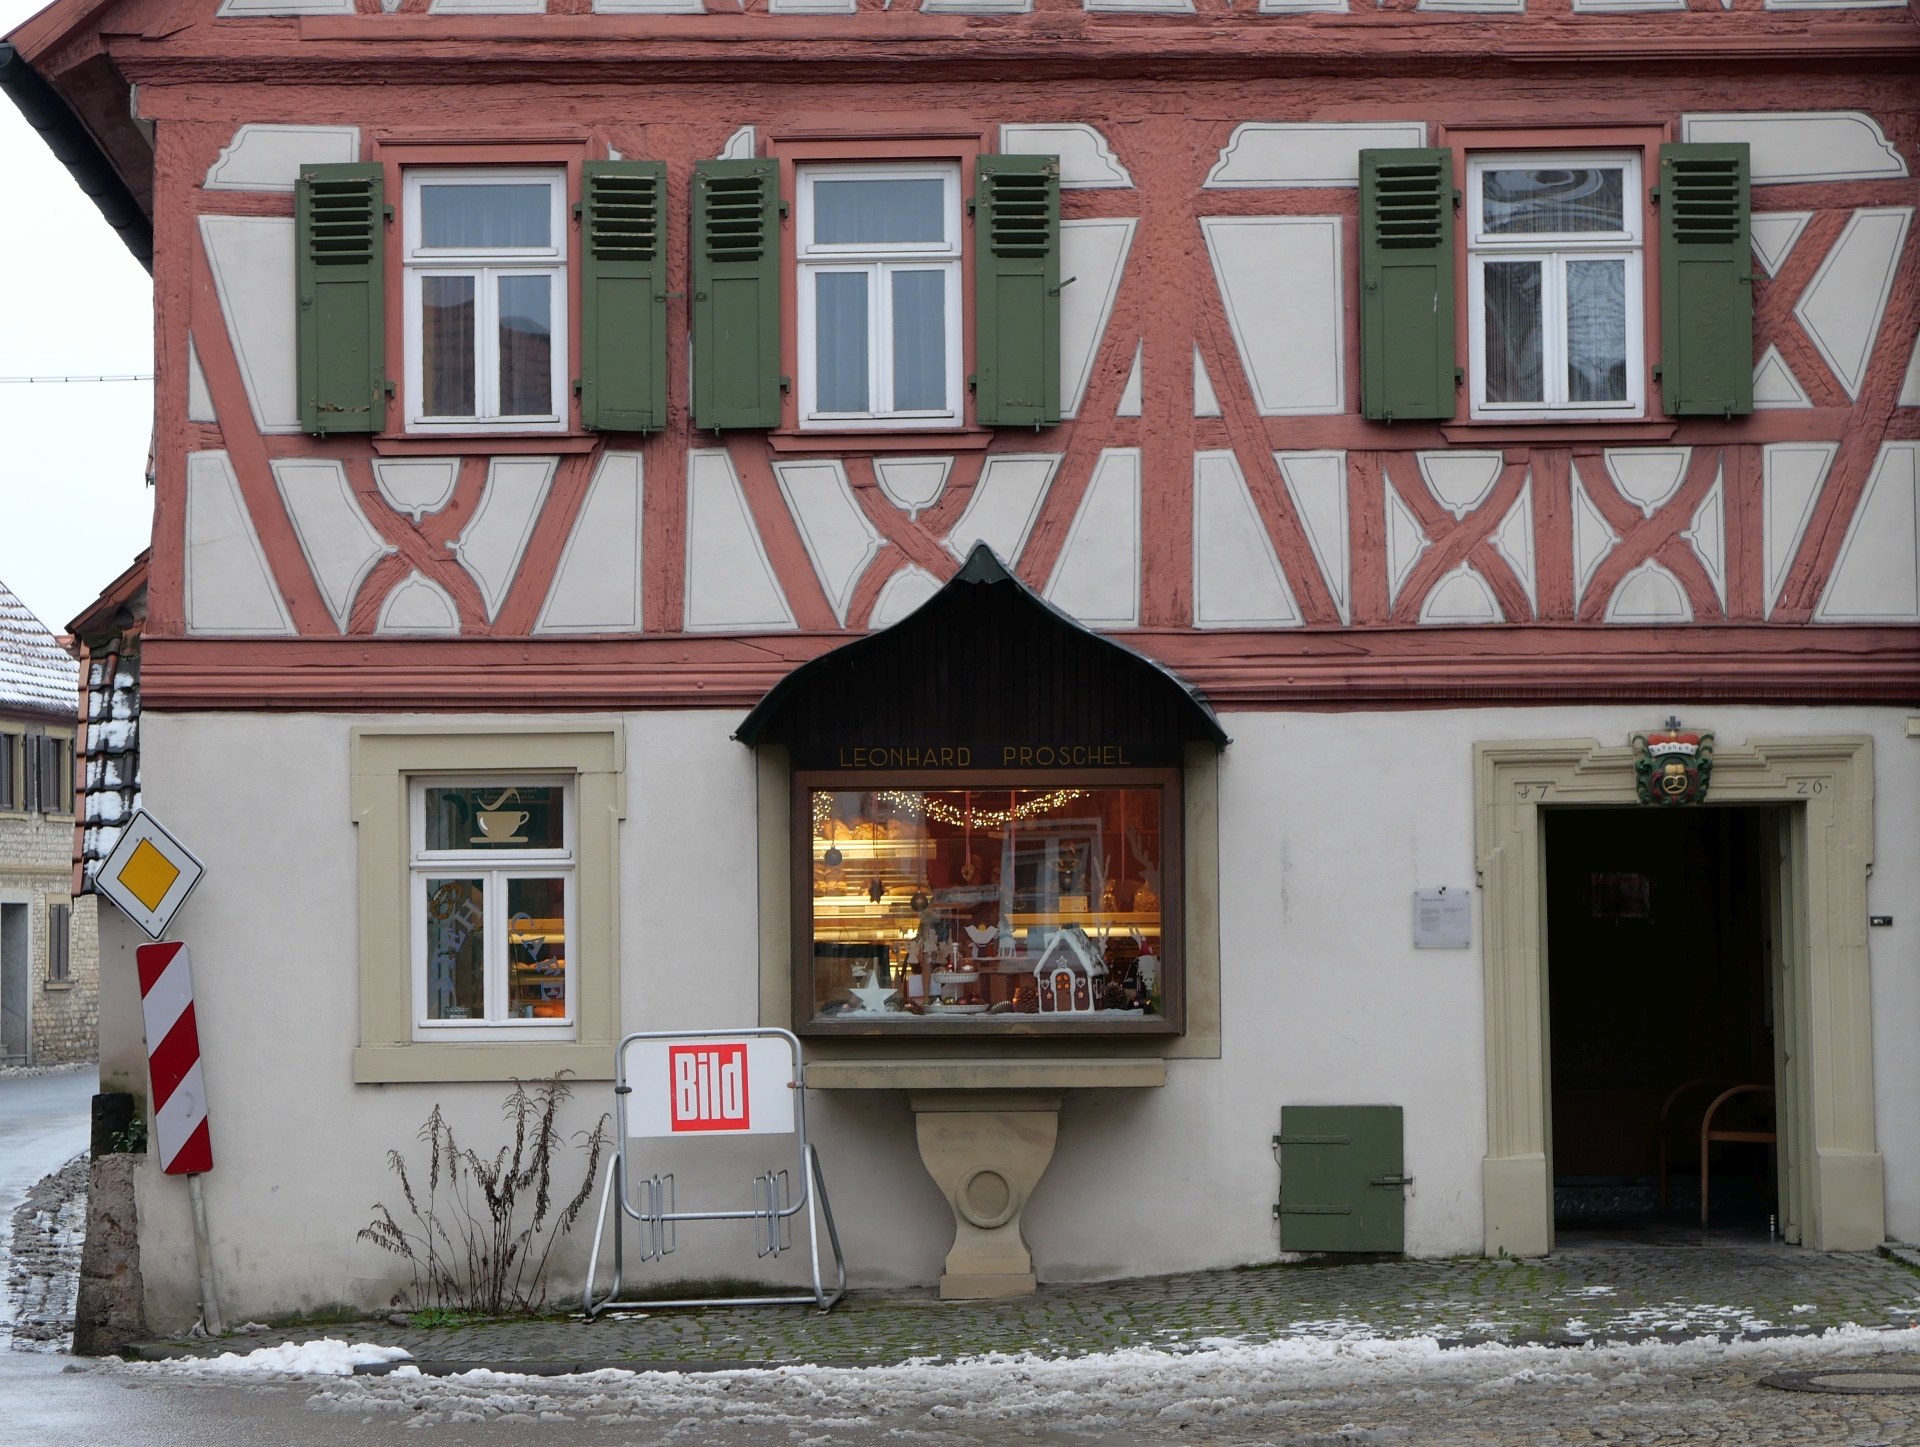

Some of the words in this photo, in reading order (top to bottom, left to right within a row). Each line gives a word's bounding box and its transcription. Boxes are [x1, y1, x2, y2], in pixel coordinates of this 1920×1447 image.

[840, 747, 971, 767] LEONHARD
[1003, 744, 1131, 766] PRÖSCHEL
[430, 898, 484, 994] STEH
[674, 1051, 744, 1121] Bild
